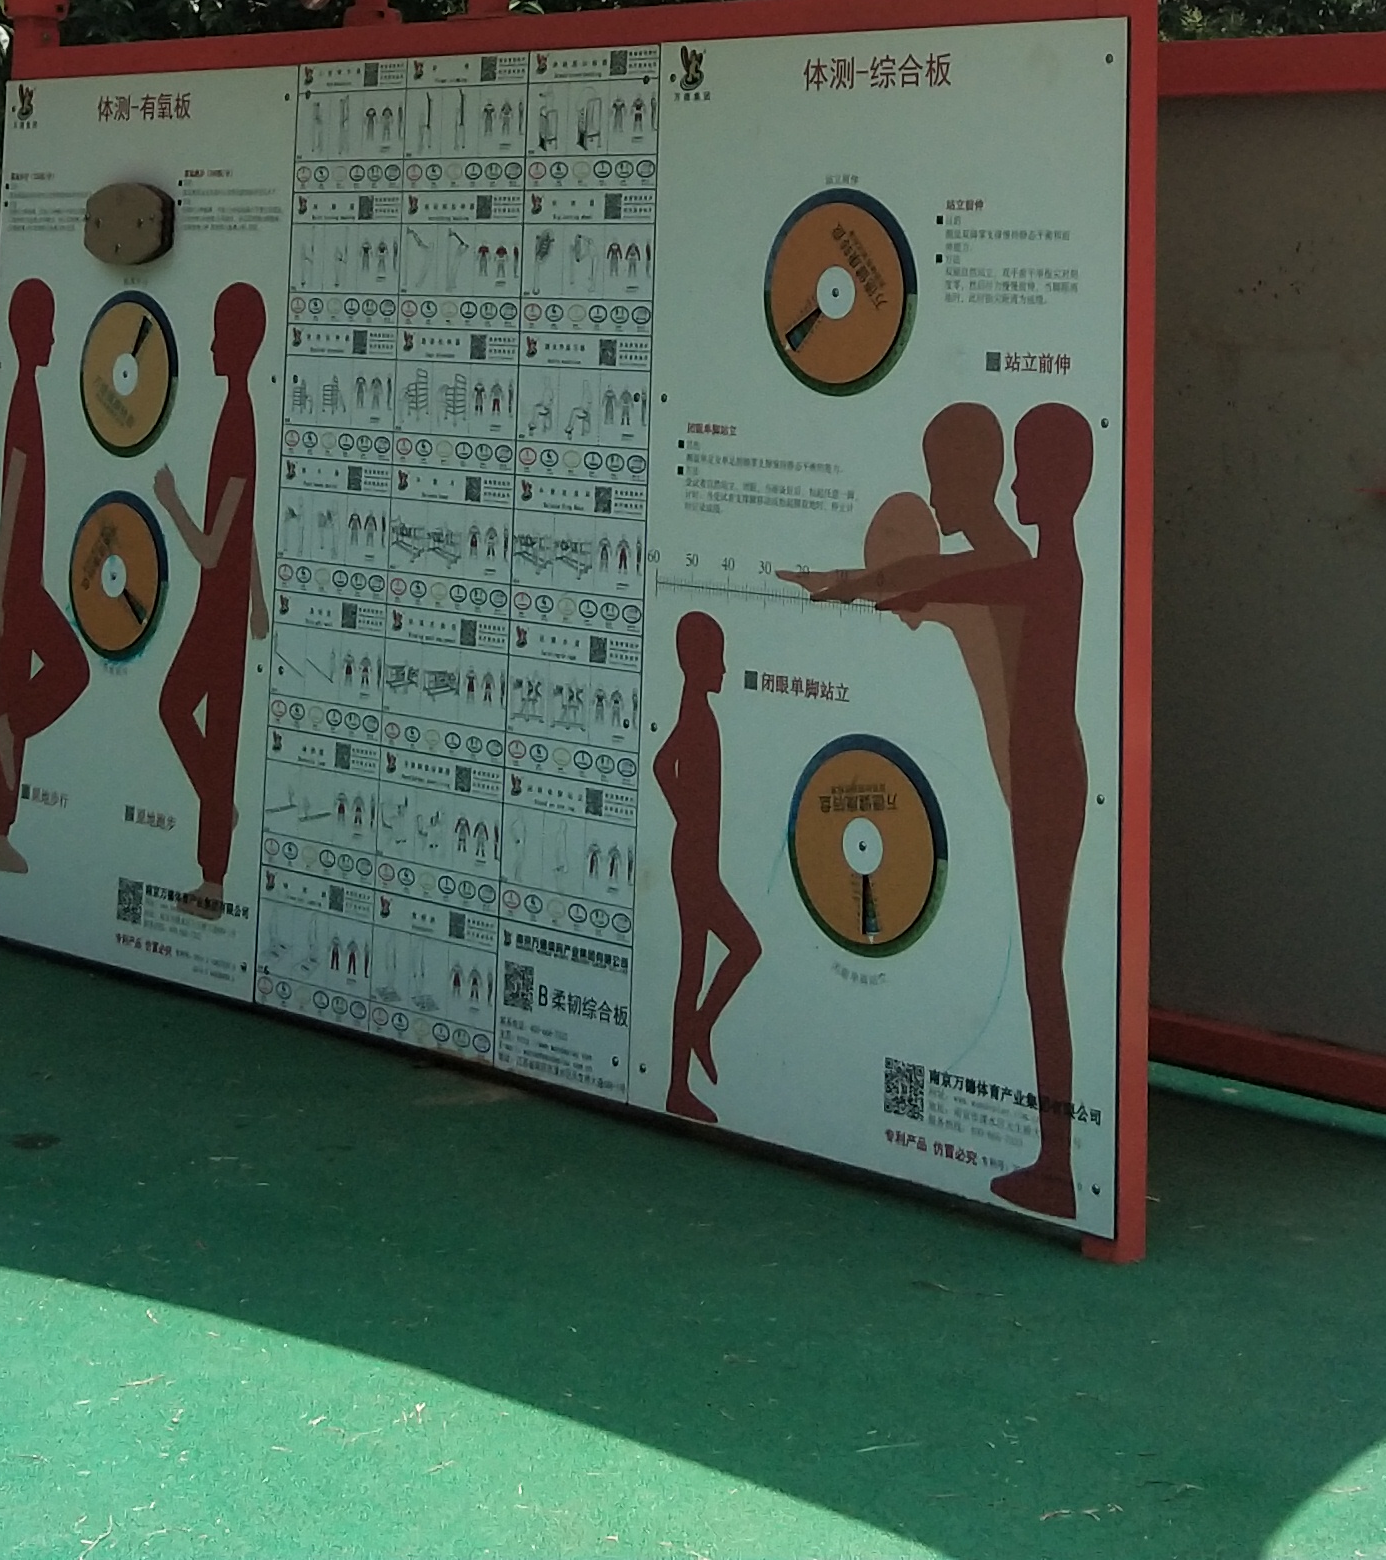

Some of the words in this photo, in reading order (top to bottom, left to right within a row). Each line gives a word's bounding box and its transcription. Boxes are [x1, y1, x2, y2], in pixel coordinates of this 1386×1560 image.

[803, 52, 952, 91] 体测-综合板
[97, 92, 192, 123] 体测-有氧板
[1004, 351, 1072, 376] 站立前伸
[647, 549, 661, 564] 60
[685, 553, 699, 568] 50
[721, 557, 735, 572] 40
[758, 560, 772, 575] 30
[761, 671, 851, 704] 闭眼单脚站立
[538, 984, 549, 1008] B
[551, 987, 629, 1029] 柔韧综合板
[884, 1127, 928, 1153] 专利产品
